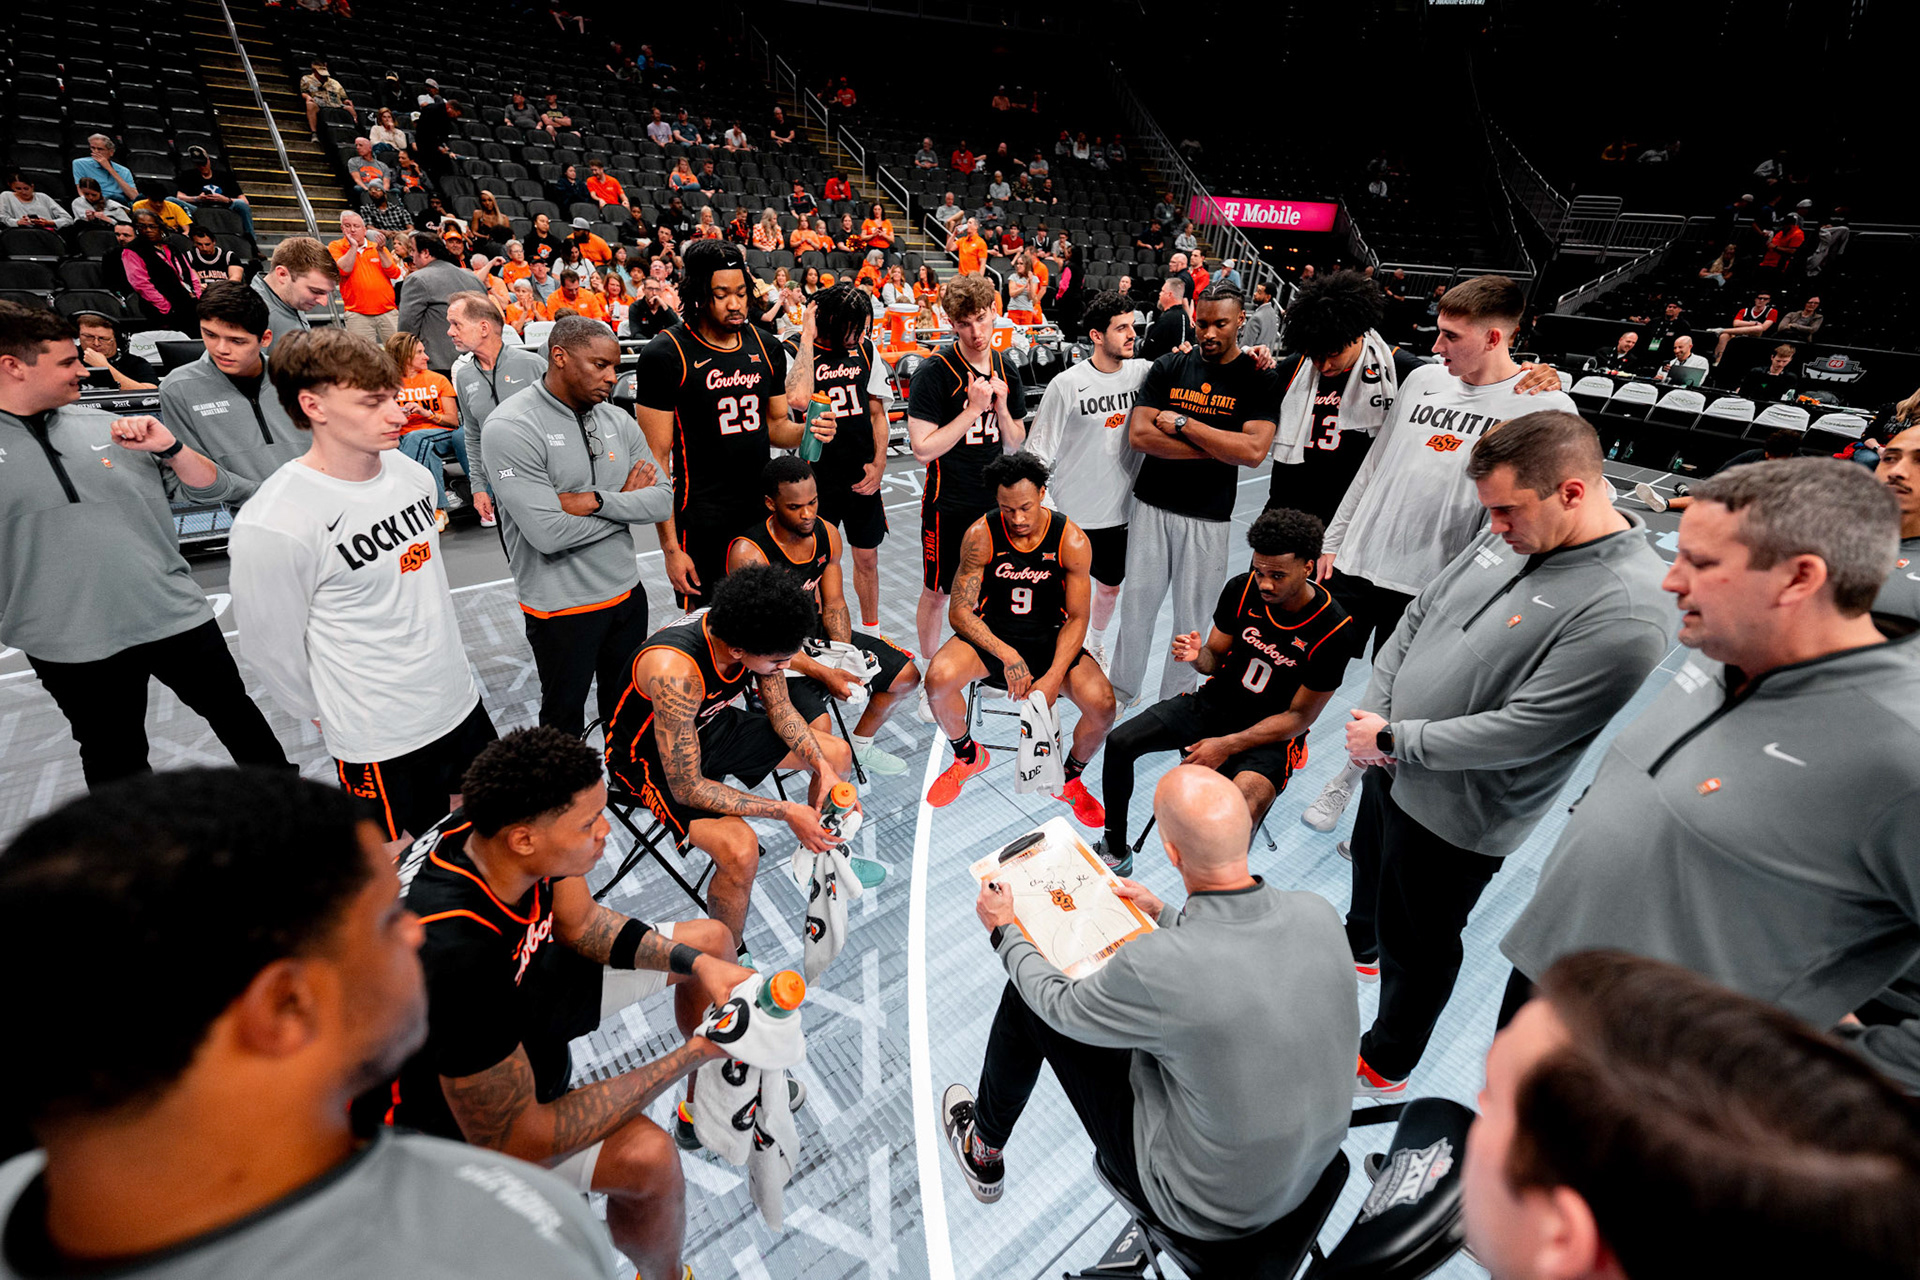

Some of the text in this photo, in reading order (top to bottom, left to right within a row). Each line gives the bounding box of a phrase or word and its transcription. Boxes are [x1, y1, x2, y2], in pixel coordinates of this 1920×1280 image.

[1241, 203, 1301, 225] Mobile
[904, 318, 915, 332] G
[991, 331, 1002, 347] G
[706, 368, 762, 390] Cowboys
[815, 363, 862, 381] Cowboys
[396, 384, 439, 401] STOLS
[827, 384, 864, 418] 21
[1079, 395, 1116, 416] LOCK
[1117, 392, 1129, 410] IT
[1210, 394, 1237, 410] STATE
[717, 393, 761, 435] 23
[1408, 404, 1462, 432] LOCK
[1456, 412, 1485, 435] IT
[966, 412, 999, 445] 24
[1303, 413, 1342, 451] 13
[1425, 433, 1465, 452] OSU
[336, 495, 436, 571] LOCK IT IN
[924, 529, 936, 562] POKES
[399, 541, 431, 575] OSU
[995, 562, 1052, 584] Cowboys
[1010, 587, 1033, 615] 9
[1241, 626, 1298, 667] Cowboys
[1241, 657, 1273, 694] 0
[1020, 765, 1042, 781] ADE
[640, 783, 666, 826] POKES
[978, 1183, 1003, 1195] NIK
